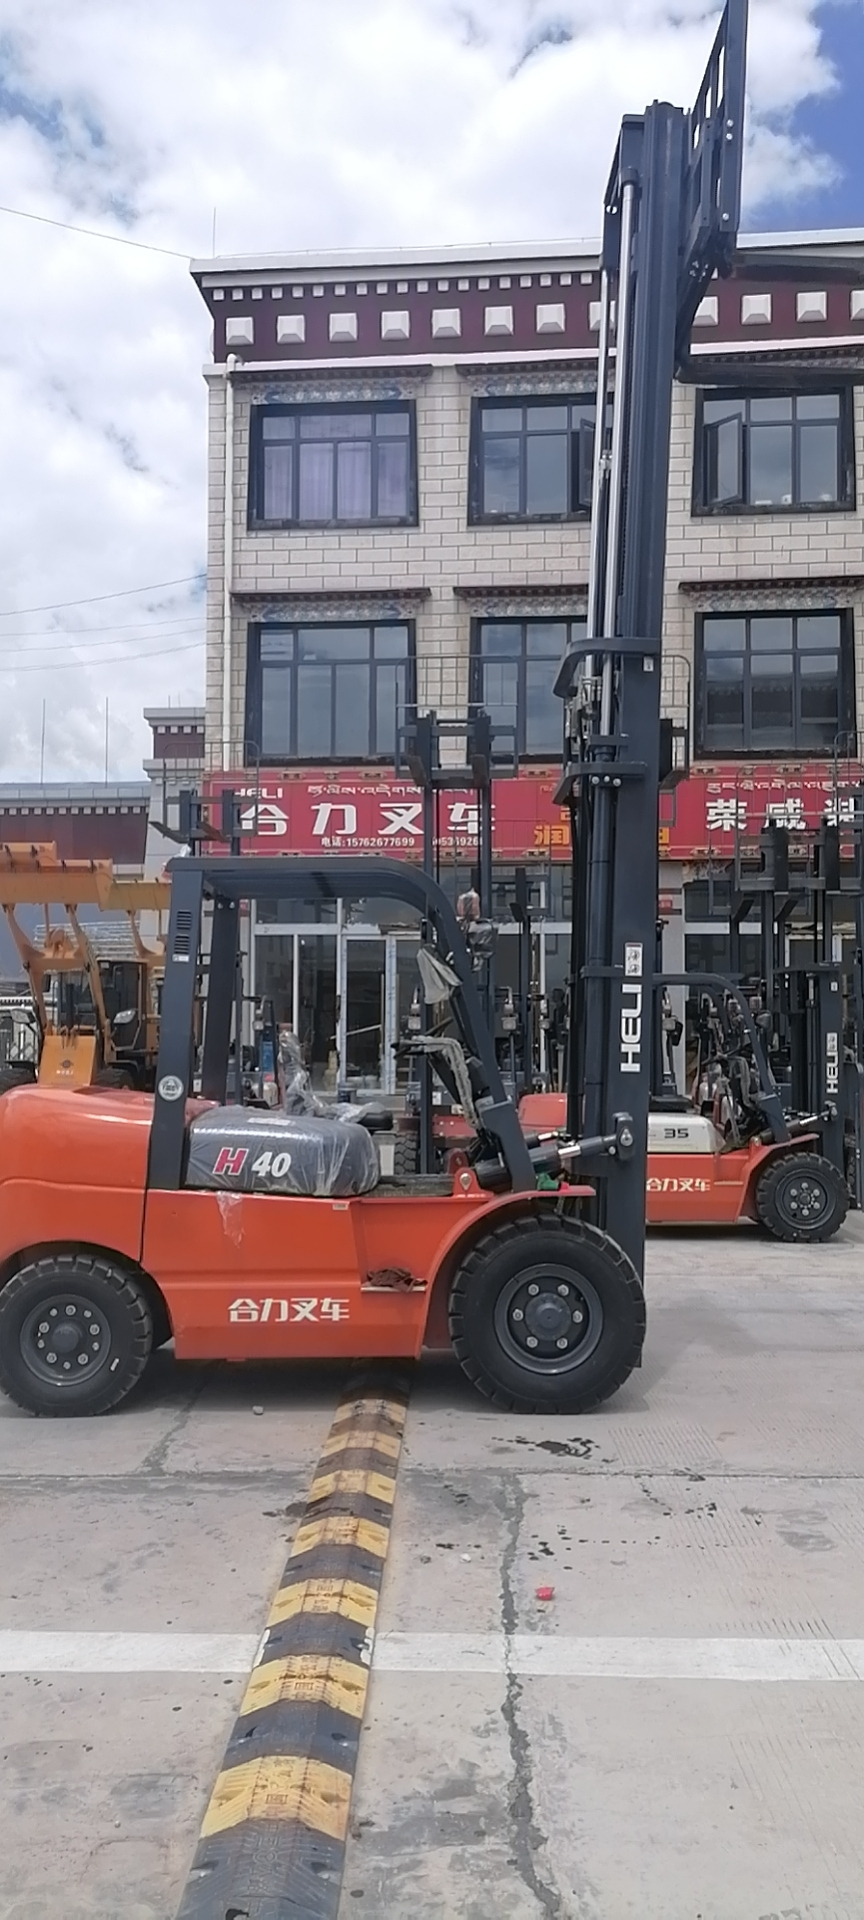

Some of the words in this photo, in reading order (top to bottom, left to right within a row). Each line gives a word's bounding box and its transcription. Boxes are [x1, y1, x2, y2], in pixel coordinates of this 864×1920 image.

[240, 803, 496, 836] 合力叉车
[620, 983, 642, 1072] HELI
[826, 1051, 838, 1094] HELI
[664, 1128, 689, 1139] 35
[212, 1146, 249, 1175] H
[251, 1151, 292, 1177] 40
[646, 1177, 711, 1192] 合力叉车
[228, 1298, 350, 1322] 合力叉车
